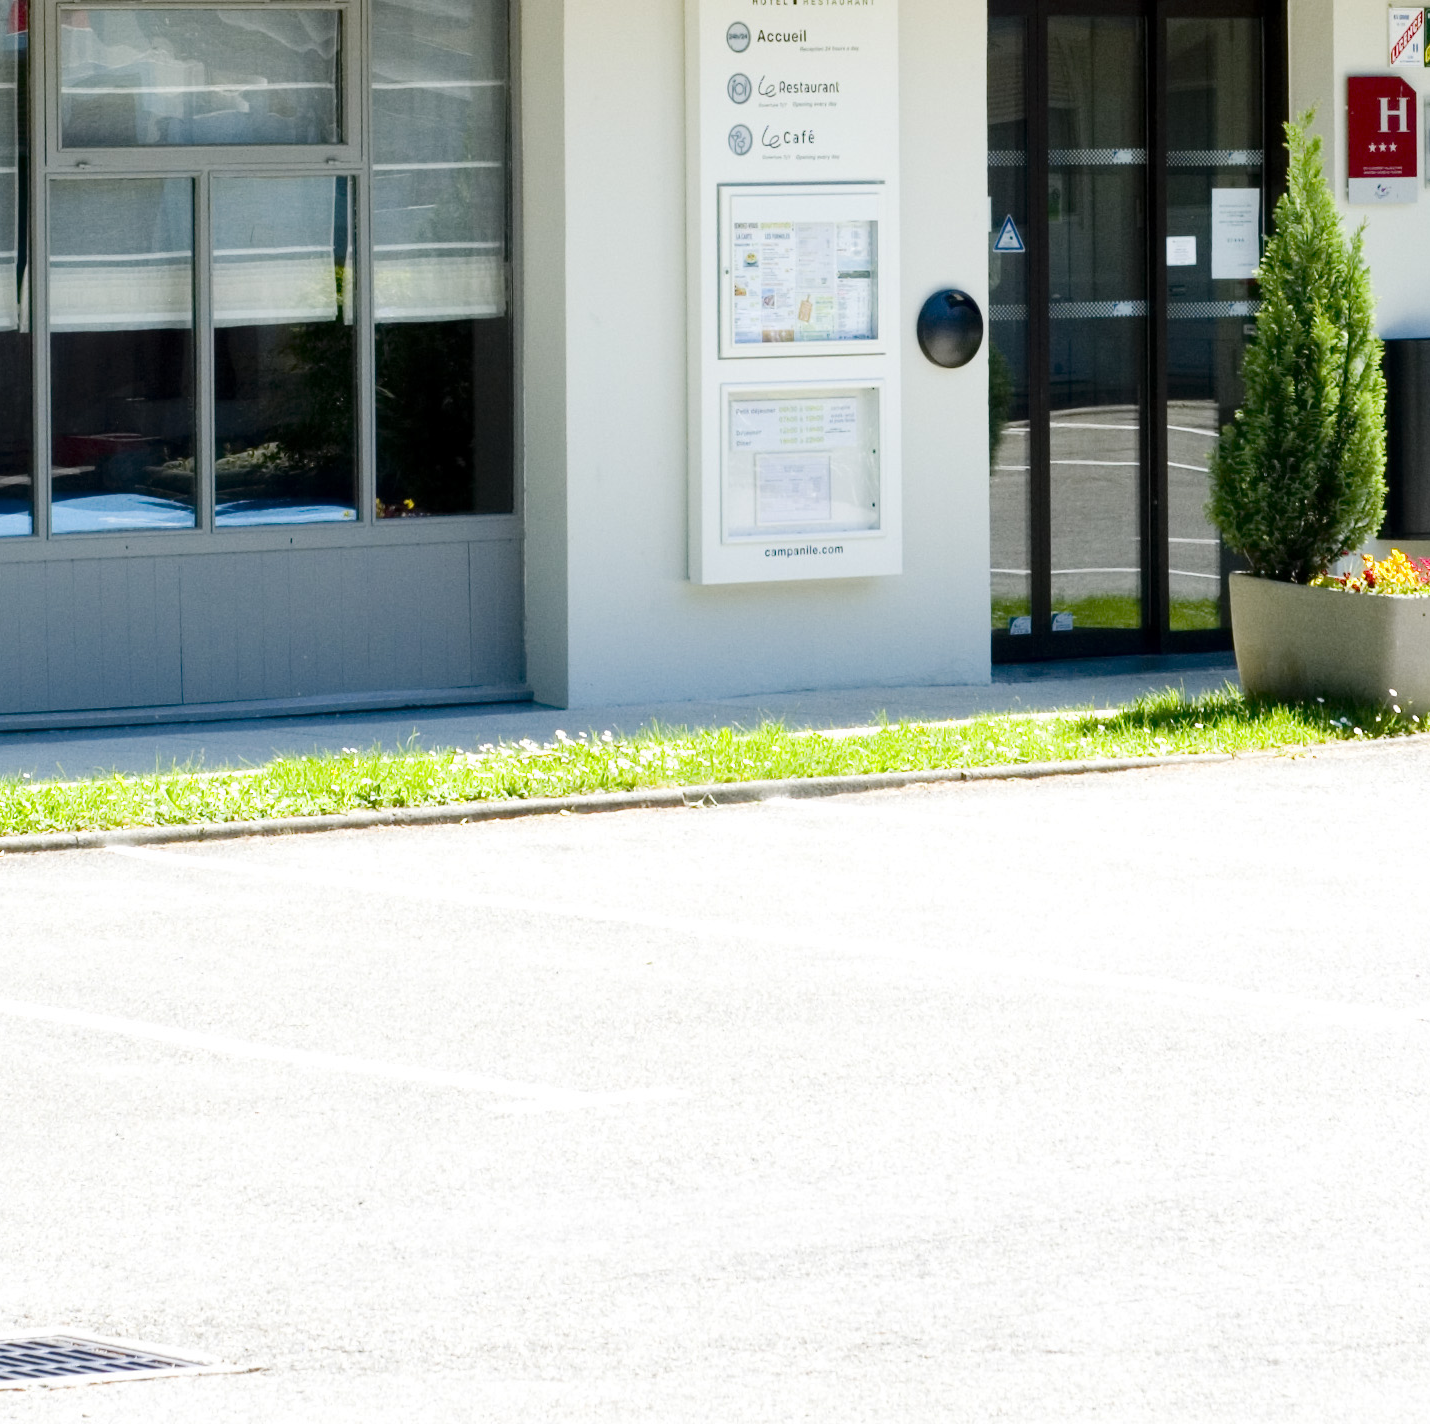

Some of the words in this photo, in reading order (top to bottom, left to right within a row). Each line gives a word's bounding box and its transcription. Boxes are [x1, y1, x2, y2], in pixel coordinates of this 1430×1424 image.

[757, 29, 807, 43] Accueil
[1390, 10, 1423, 64] LICENCE
[758, 75, 777, 97] Le
[779, 80, 840, 94] Restaurant
[1377, 97, 1411, 133] H
[761, 125, 781, 149] Le
[783, 129, 816, 144] Café
[764, 545, 844, 558] campanile.com
